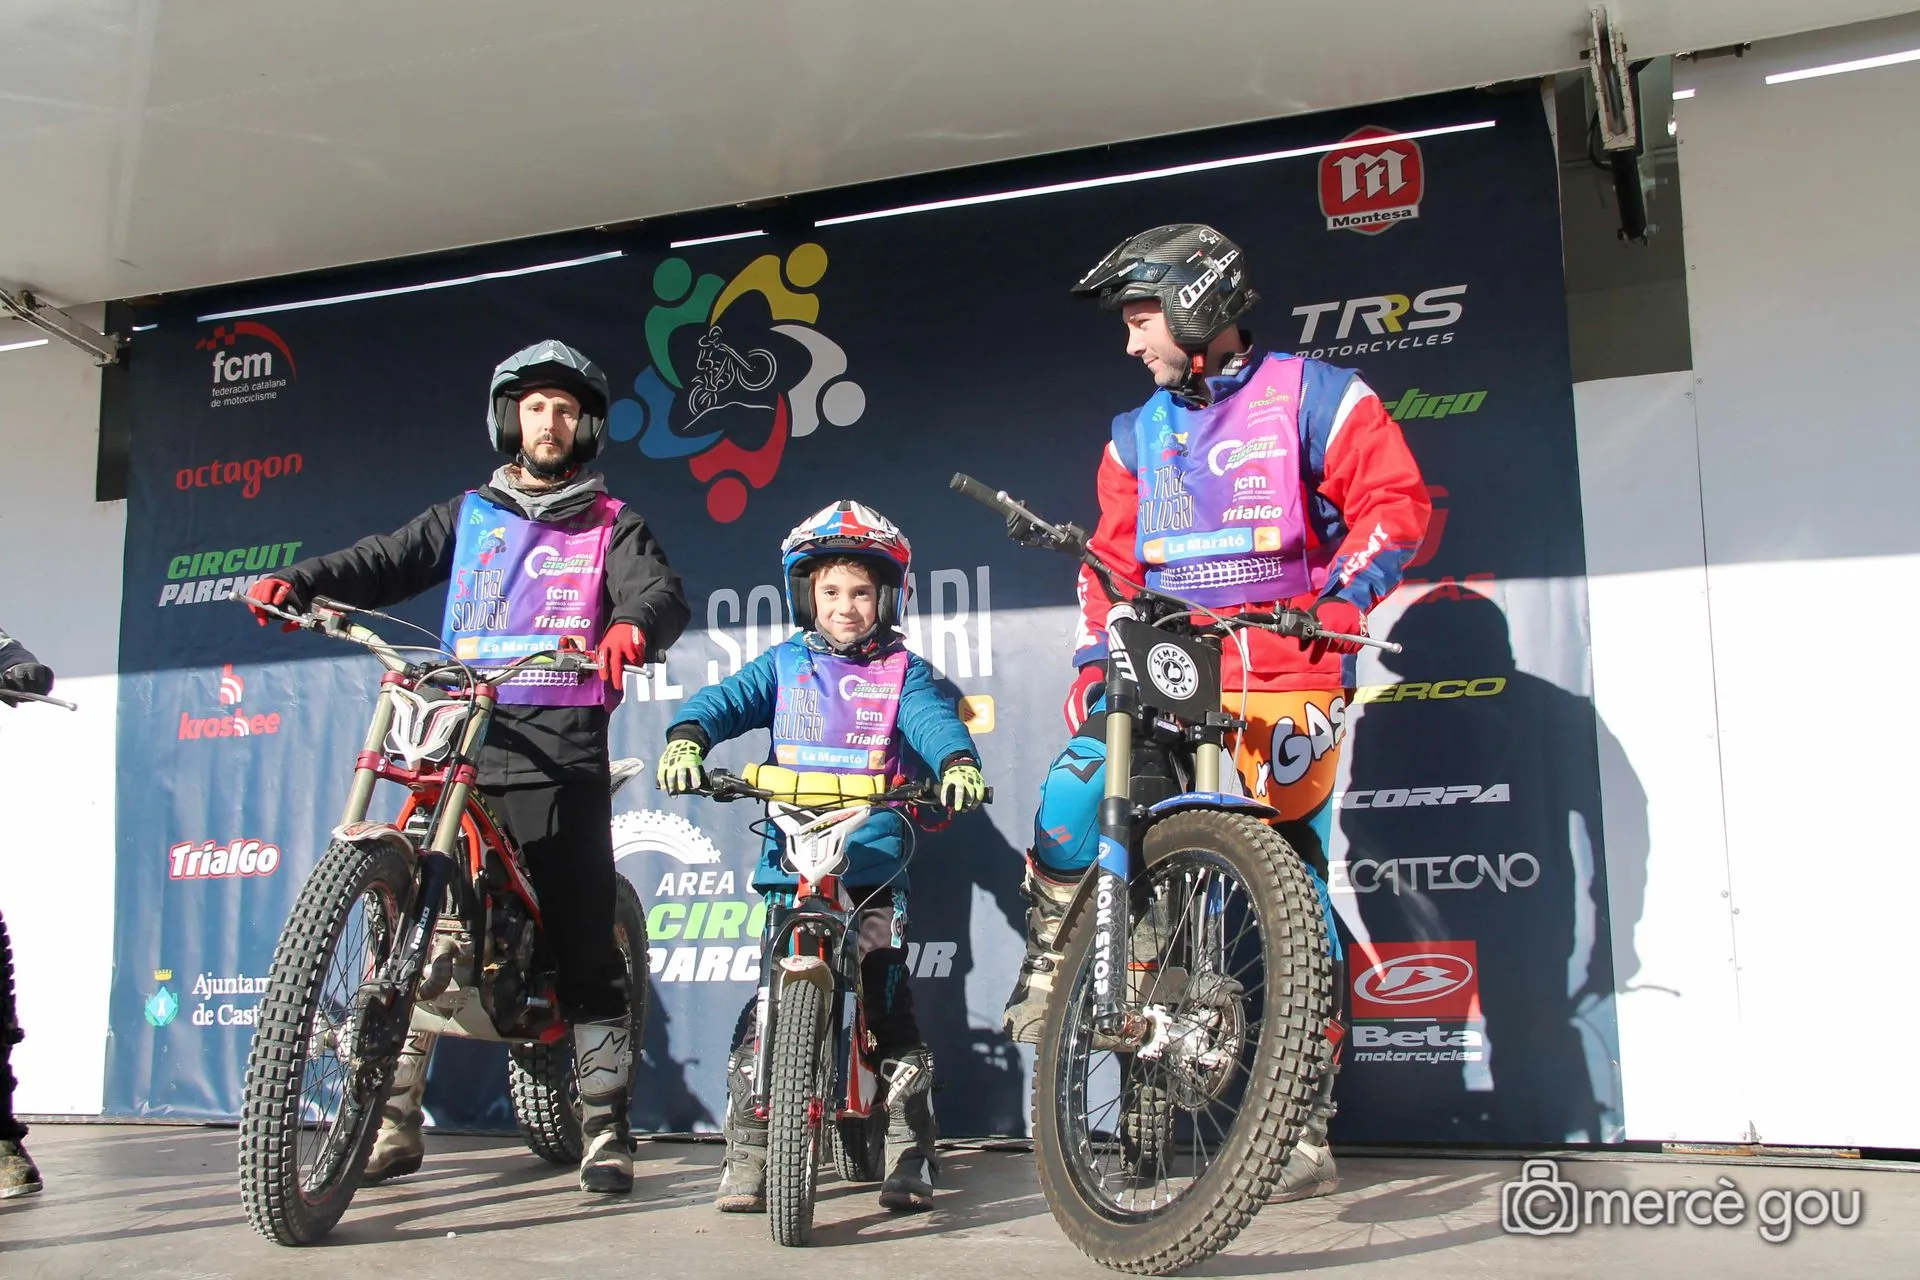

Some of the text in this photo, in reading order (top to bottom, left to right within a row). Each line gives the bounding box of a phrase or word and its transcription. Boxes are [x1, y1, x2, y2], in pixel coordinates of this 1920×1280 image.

[1332, 208, 1412, 228] Montesa
[1295, 332, 1456, 359] MOTORCYCLES
[213, 350, 272, 384] fcm
[252, 379, 287, 391] catalana
[211, 391, 277, 408] de motociclisme
[176, 453, 303, 498] octagon
[1234, 475, 1266, 492] fcm
[1222, 505, 1283, 523] TrialGo
[167, 541, 303, 579] CIRCUIT
[546, 586, 579, 601] fcm
[534, 615, 591, 629] TrialGo
[1154, 649, 1191, 670] SEMPRE
[1352, 677, 1507, 705] ERCO
[856, 707, 883, 722] fcm
[846, 732, 892, 746] TrialGo
[170, 839, 280, 878] TrialGo
[655, 870, 735, 897] AREA
[1328, 852, 1541, 896] ECATECNO
[192, 1003, 214, 1026] de
[1352, 1025, 1482, 1047] Beta
[1354, 1050, 1482, 1064] motorcycles
